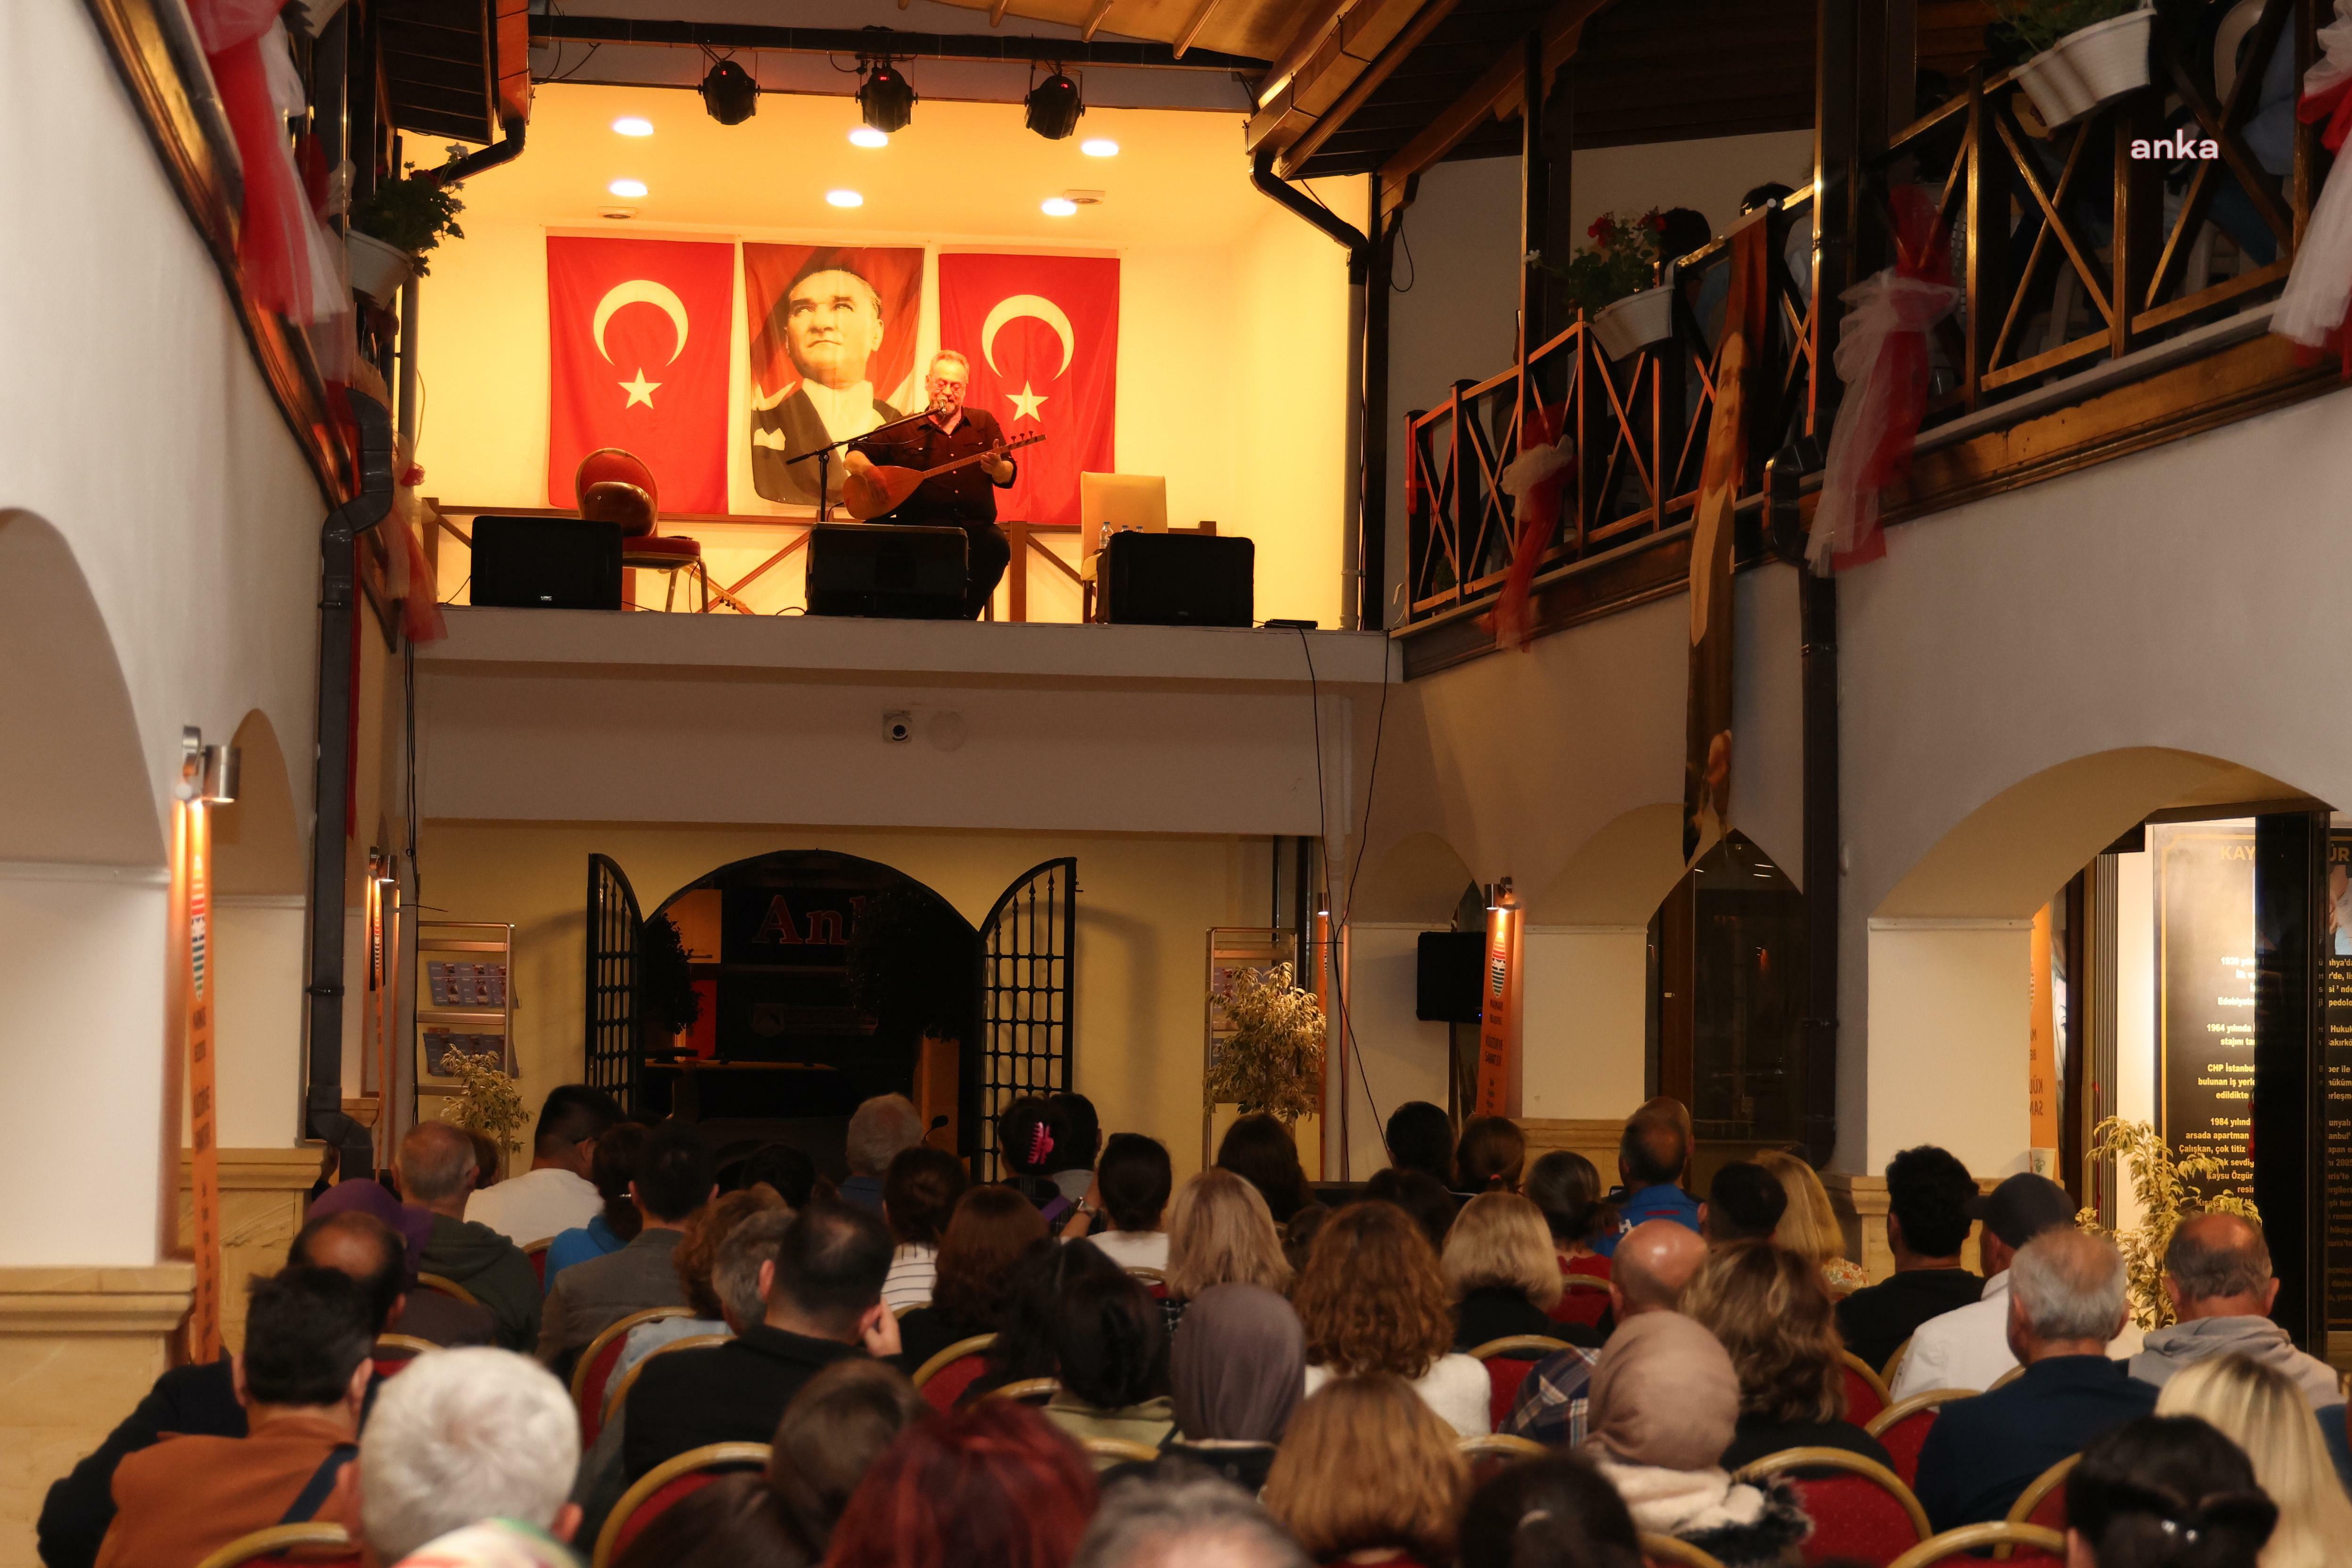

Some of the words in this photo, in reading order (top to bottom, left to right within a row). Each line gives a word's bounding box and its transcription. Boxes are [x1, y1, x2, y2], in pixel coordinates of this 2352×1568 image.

[2206, 1024, 2225, 1032] 1964
[2227, 1024, 2252, 1033] yılında
[2220, 1037, 2244, 1047] stajını
[2226, 1062, 2255, 1072] İstanbul
[2230, 1078, 2237, 1087] iş
[2213, 1132, 2249, 1140] apartman
[2179, 1144, 2213, 1154] Çalışkan,
[2215, 1145, 2229, 1154] çok
[2231, 1170, 2254, 1181] Özgür
